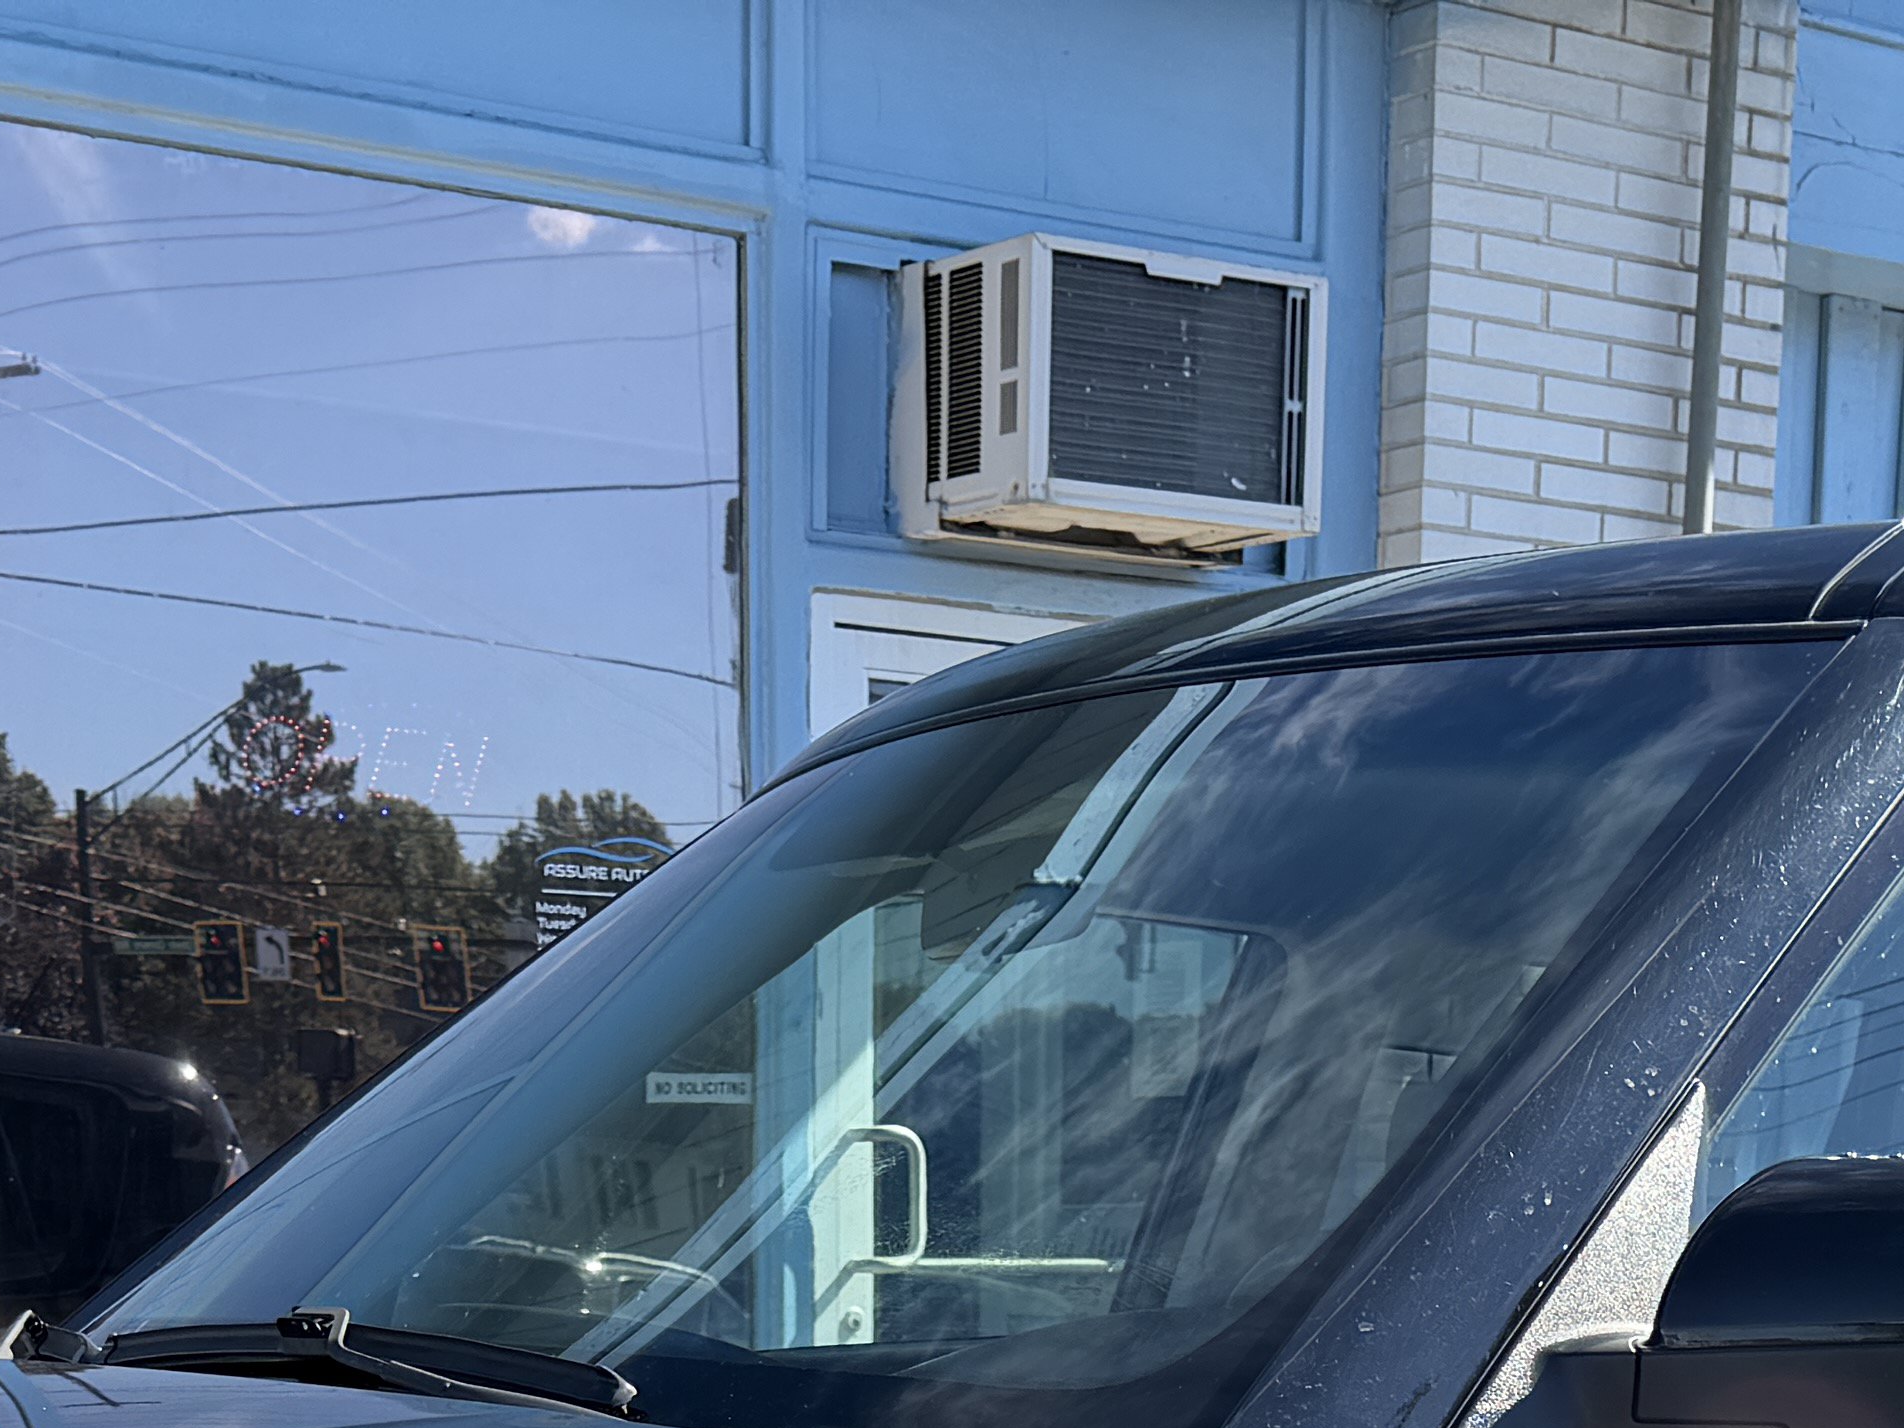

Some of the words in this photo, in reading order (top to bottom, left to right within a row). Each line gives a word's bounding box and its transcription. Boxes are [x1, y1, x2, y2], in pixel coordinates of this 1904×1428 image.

[544, 864, 608, 881] ASSURE
[611, 868, 650, 882] AUT
[535, 901, 587, 918] Monday
[536, 917, 577, 930] Tues
[655, 1082, 672, 1095] NO
